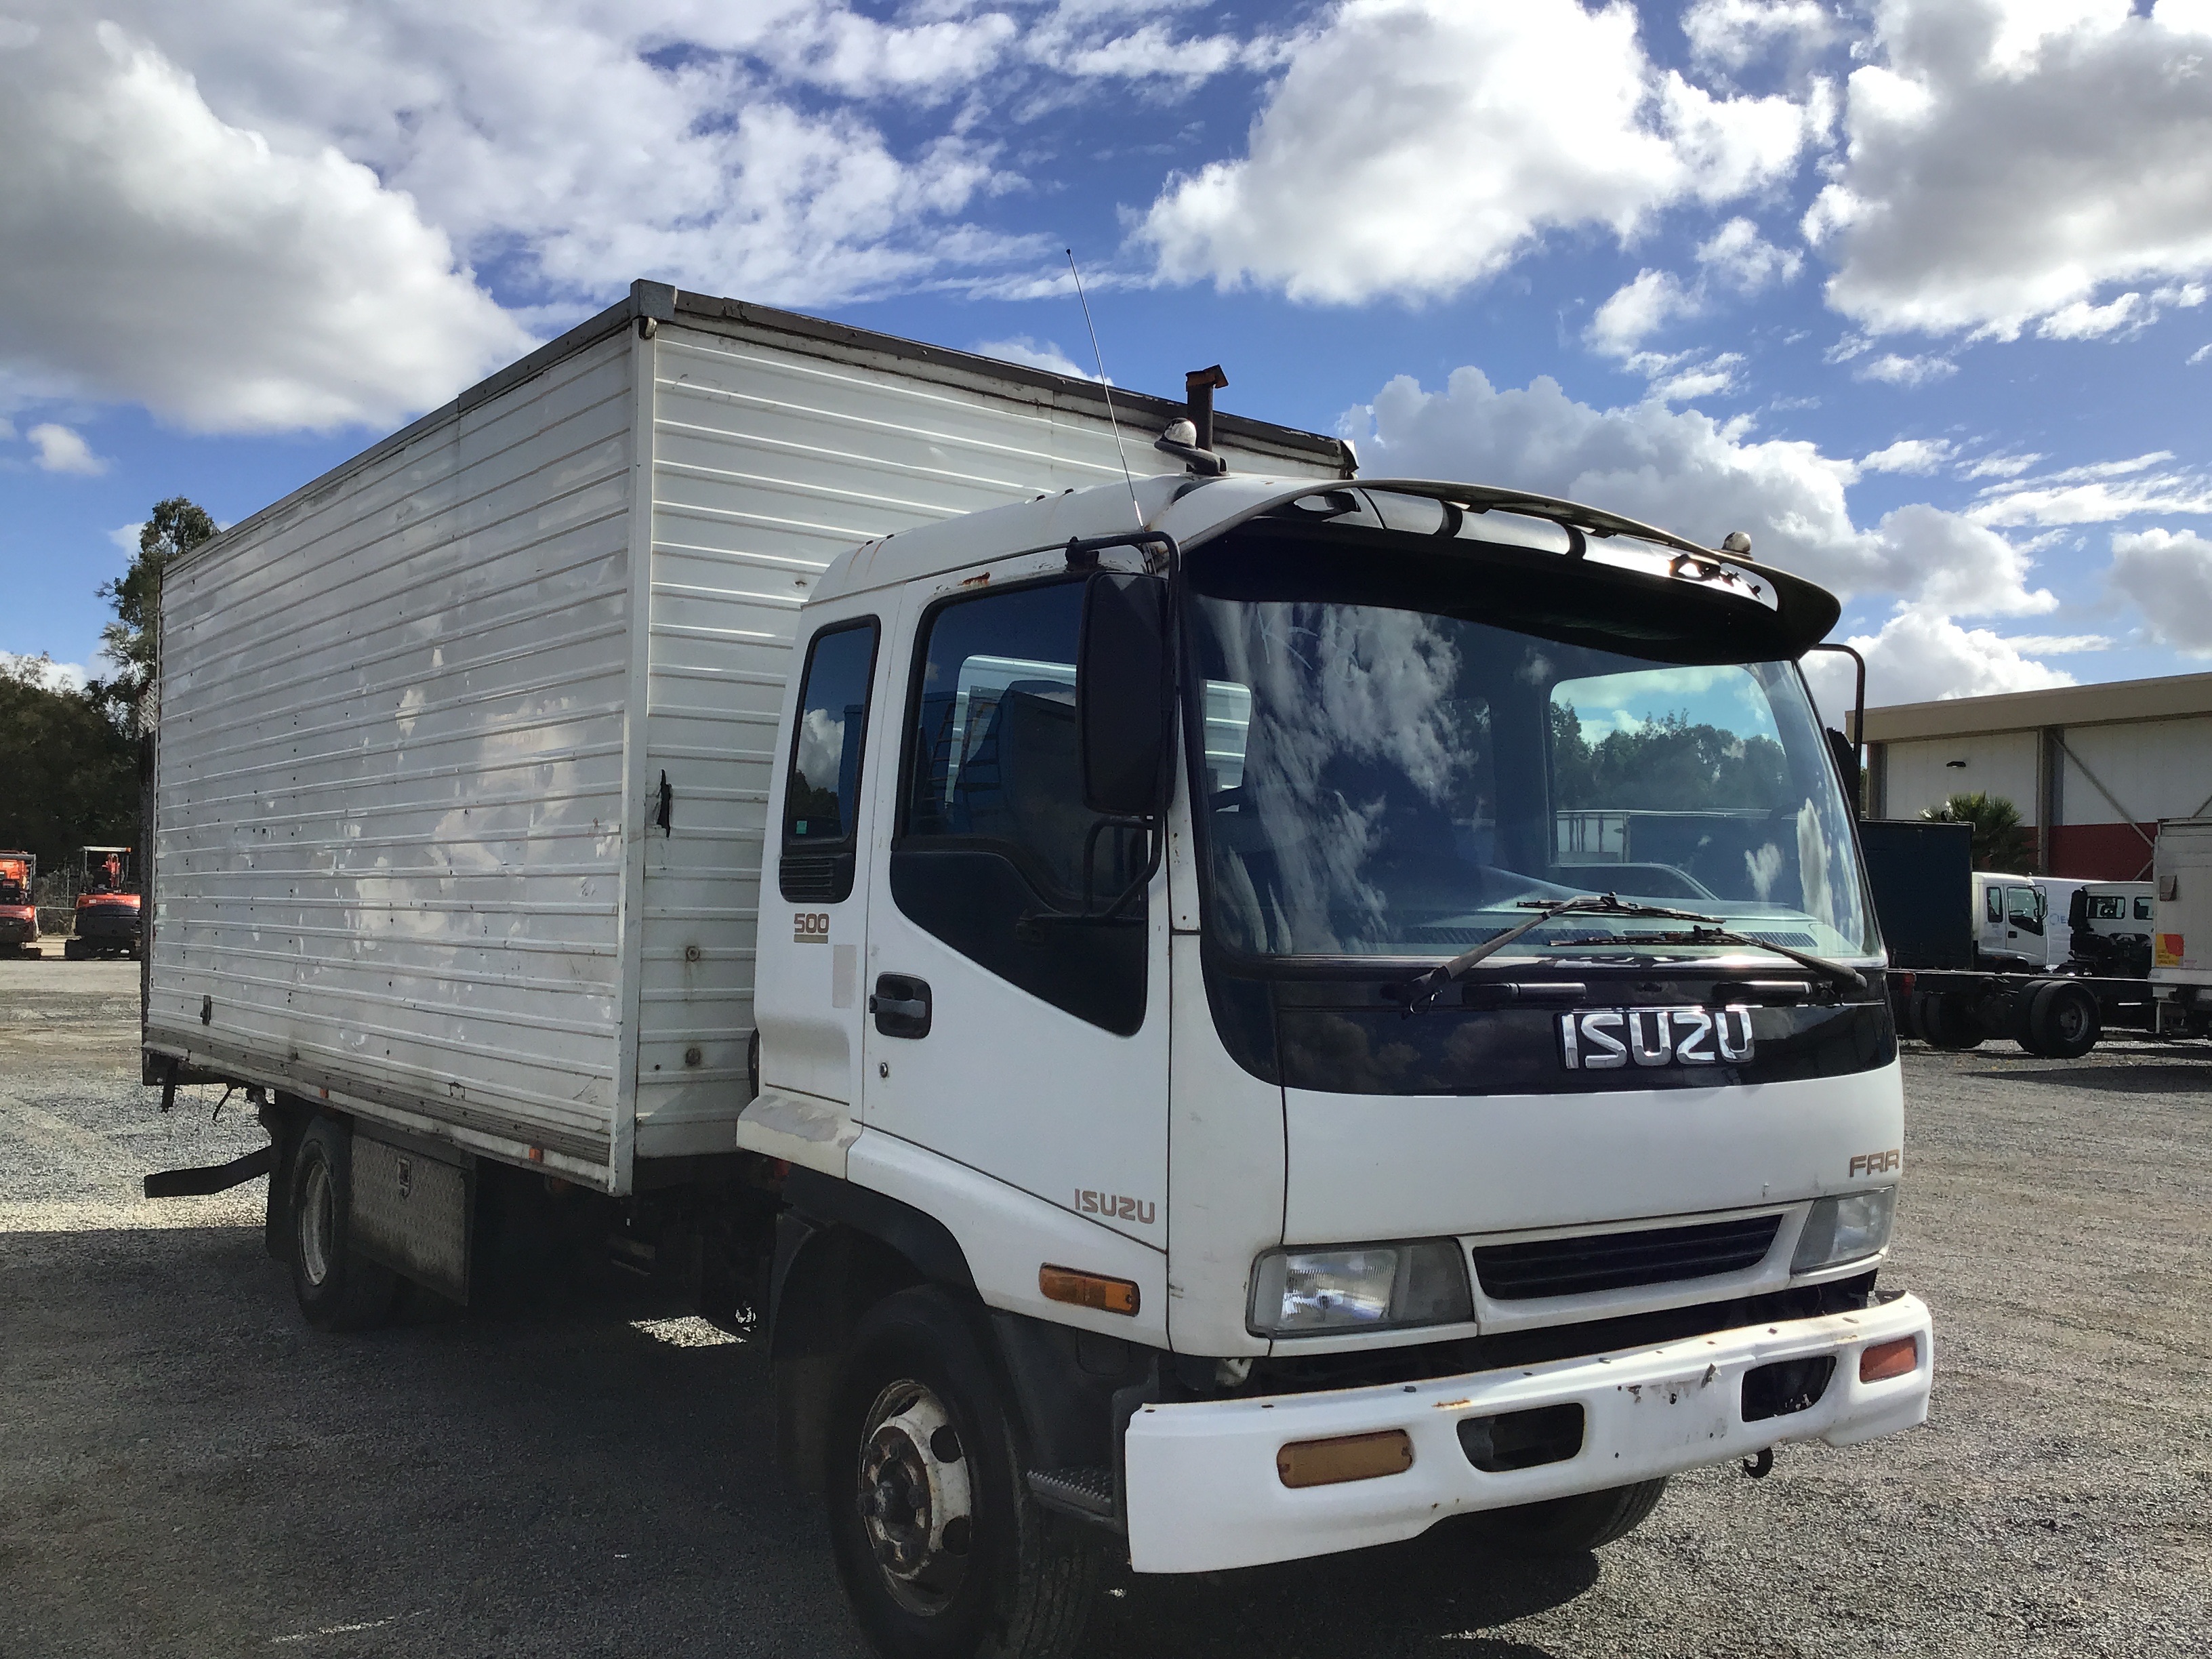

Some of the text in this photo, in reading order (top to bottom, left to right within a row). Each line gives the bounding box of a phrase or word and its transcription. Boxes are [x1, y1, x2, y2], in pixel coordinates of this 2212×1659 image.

[794, 913, 830, 934] 500
[1561, 1010, 1755, 1069] ISUZU
[1074, 1188, 1155, 1224] ISUZU
